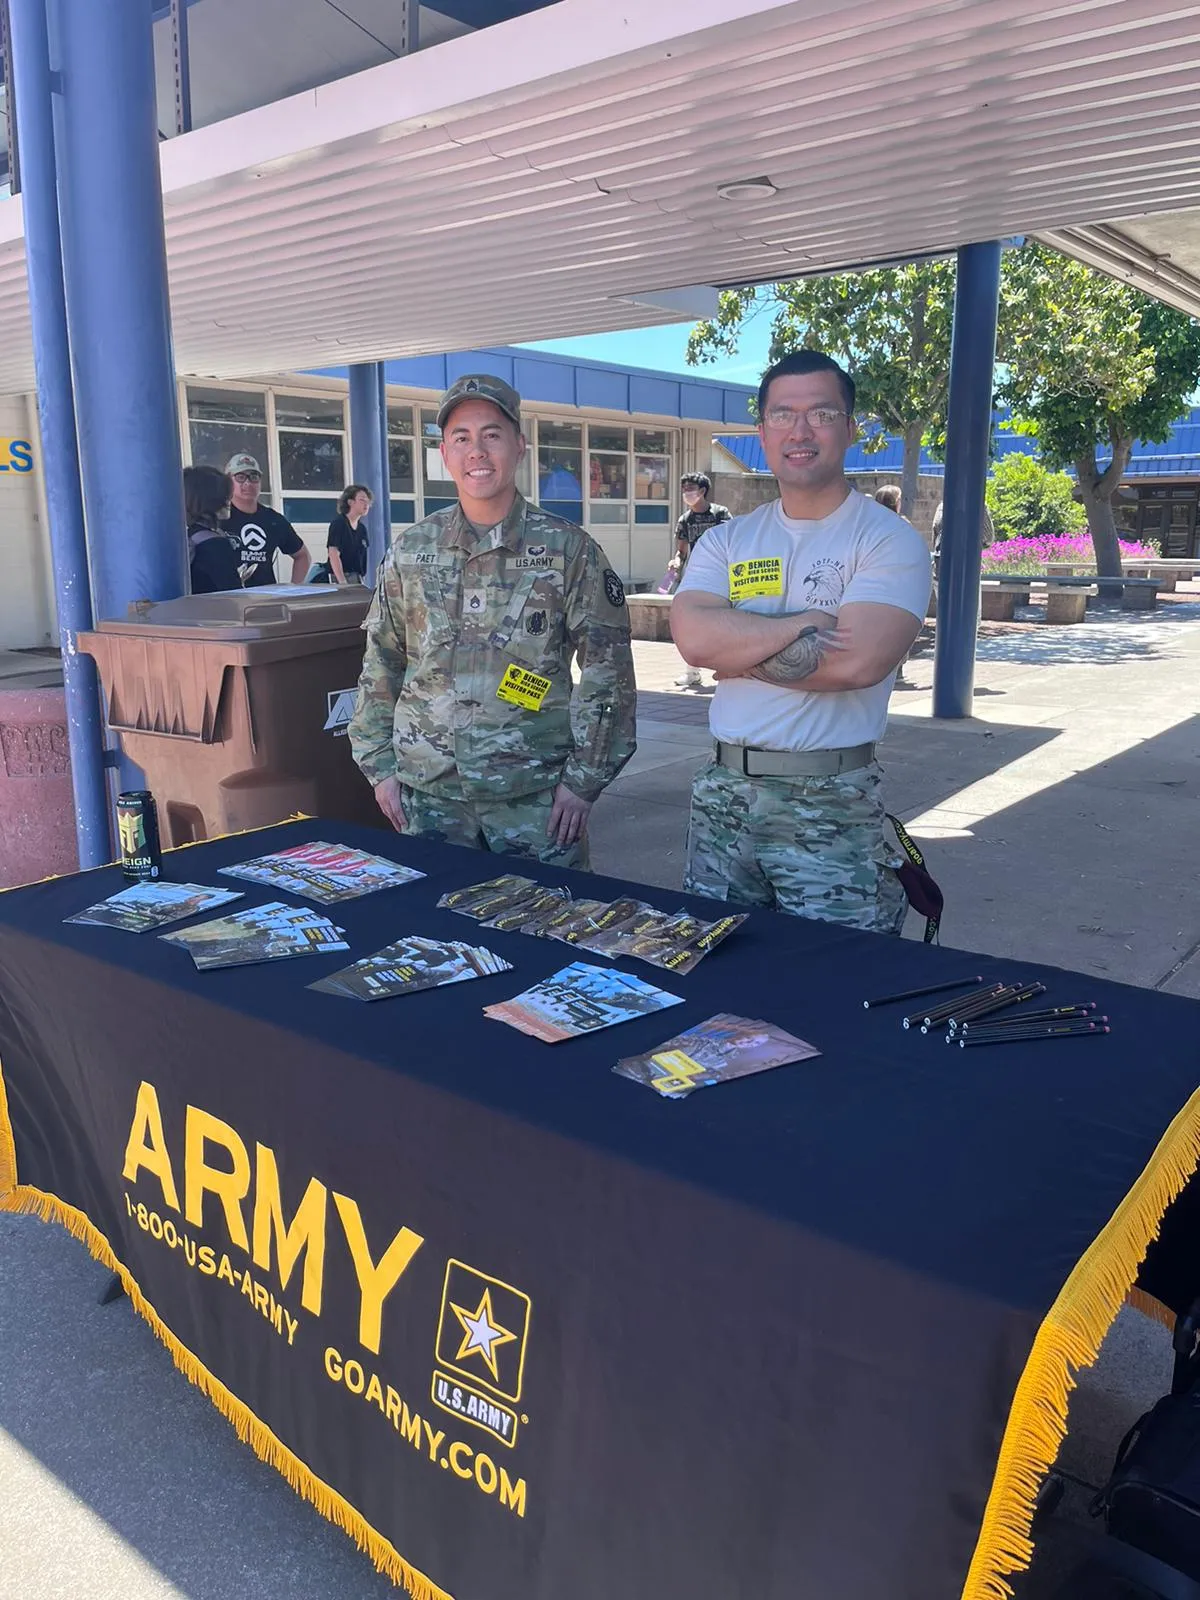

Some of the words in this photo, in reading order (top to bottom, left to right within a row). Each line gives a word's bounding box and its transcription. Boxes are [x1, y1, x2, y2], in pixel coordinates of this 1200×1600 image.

[415, 554, 436, 563] PAET
[748, 560, 780, 570] BENICIA
[734, 576, 759, 587] VISITOR
[760, 574, 779, 582] PASS
[505, 680, 527, 693] VISITOR
[526, 690, 541, 699] PASS
[523, 673, 549, 689] BENICIA
[894, 820, 923, 865] goarmy.co
[122, 856, 152, 867] EIGN
[122, 1080, 424, 1356] ARMY
[125, 1192, 298, 1346] 1-800-USA-ARMY
[324, 1347, 526, 1518] GOARMY.COM
